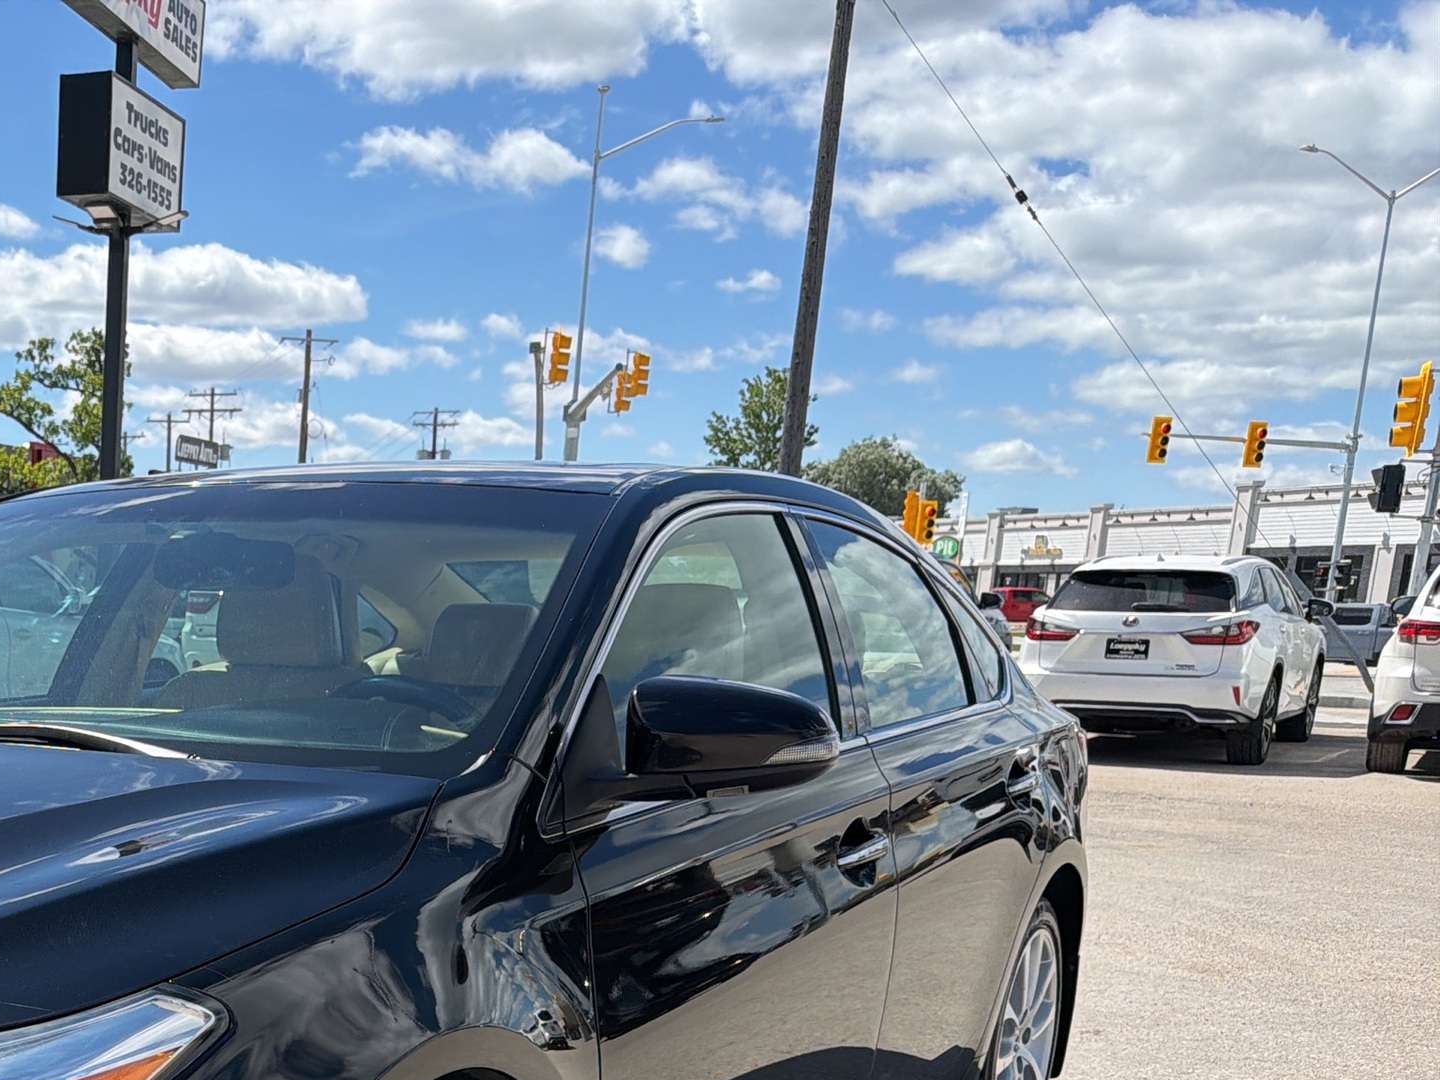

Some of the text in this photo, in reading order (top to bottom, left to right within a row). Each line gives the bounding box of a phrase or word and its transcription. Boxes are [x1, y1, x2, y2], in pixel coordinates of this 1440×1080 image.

[163, 17, 198, 63] SALES
[167, 0, 197, 37] AUTO
[126, 100, 169, 148] Trucks
[119, 163, 172, 211] 326-1555
[936, 540, 954, 555] Pit
